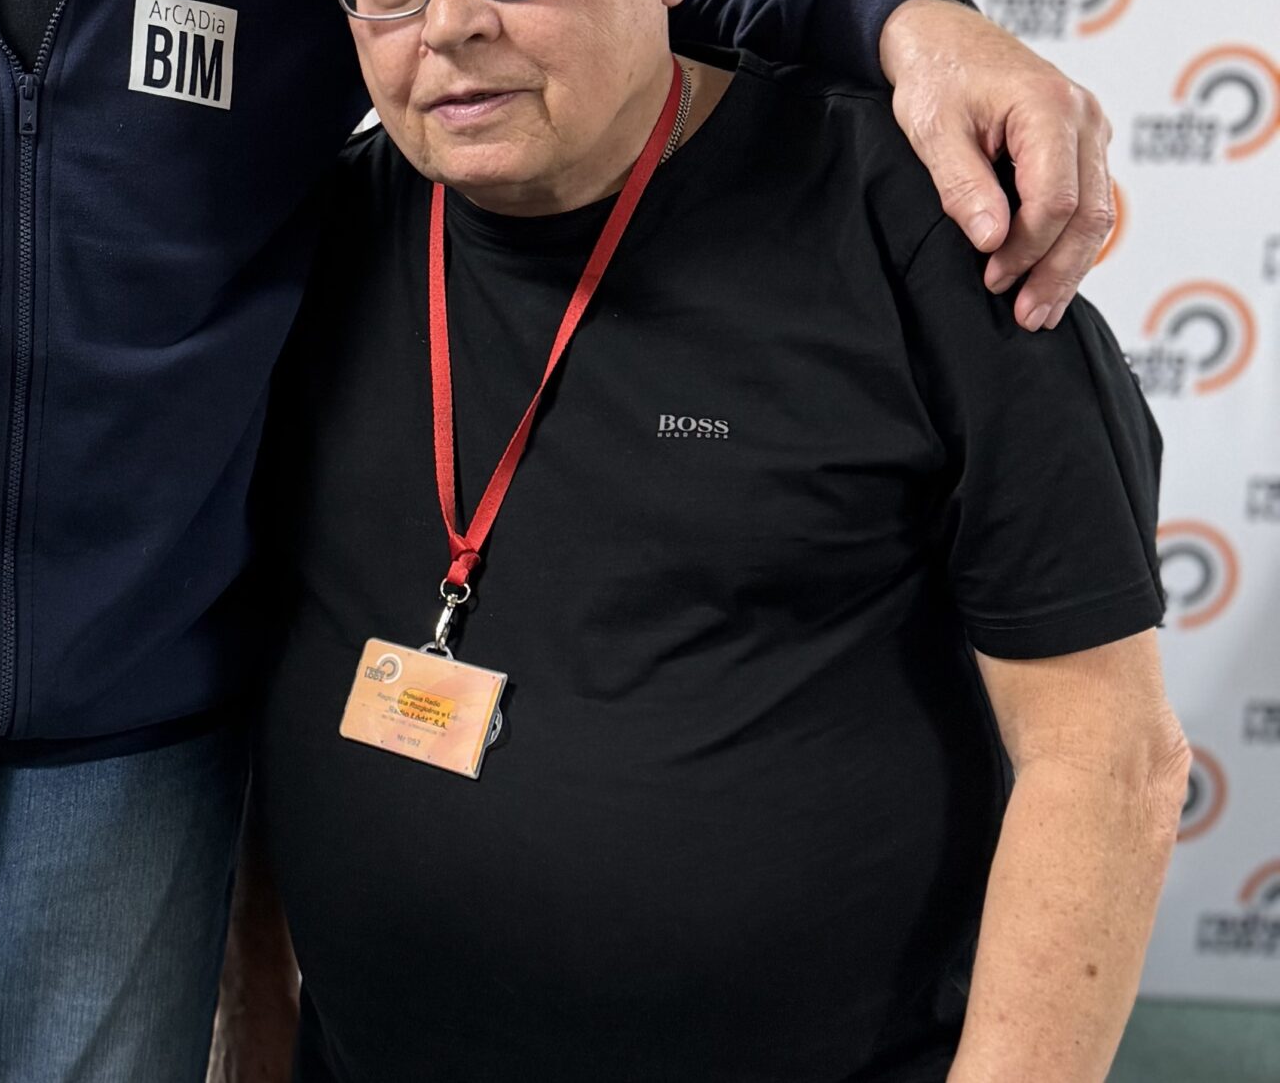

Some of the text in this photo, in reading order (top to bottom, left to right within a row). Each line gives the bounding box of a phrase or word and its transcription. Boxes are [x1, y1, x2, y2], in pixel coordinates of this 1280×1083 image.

[149, 0, 225, 34] ArCADia
[143, 24, 224, 102] BIM
[658, 414, 729, 433] BOSS
